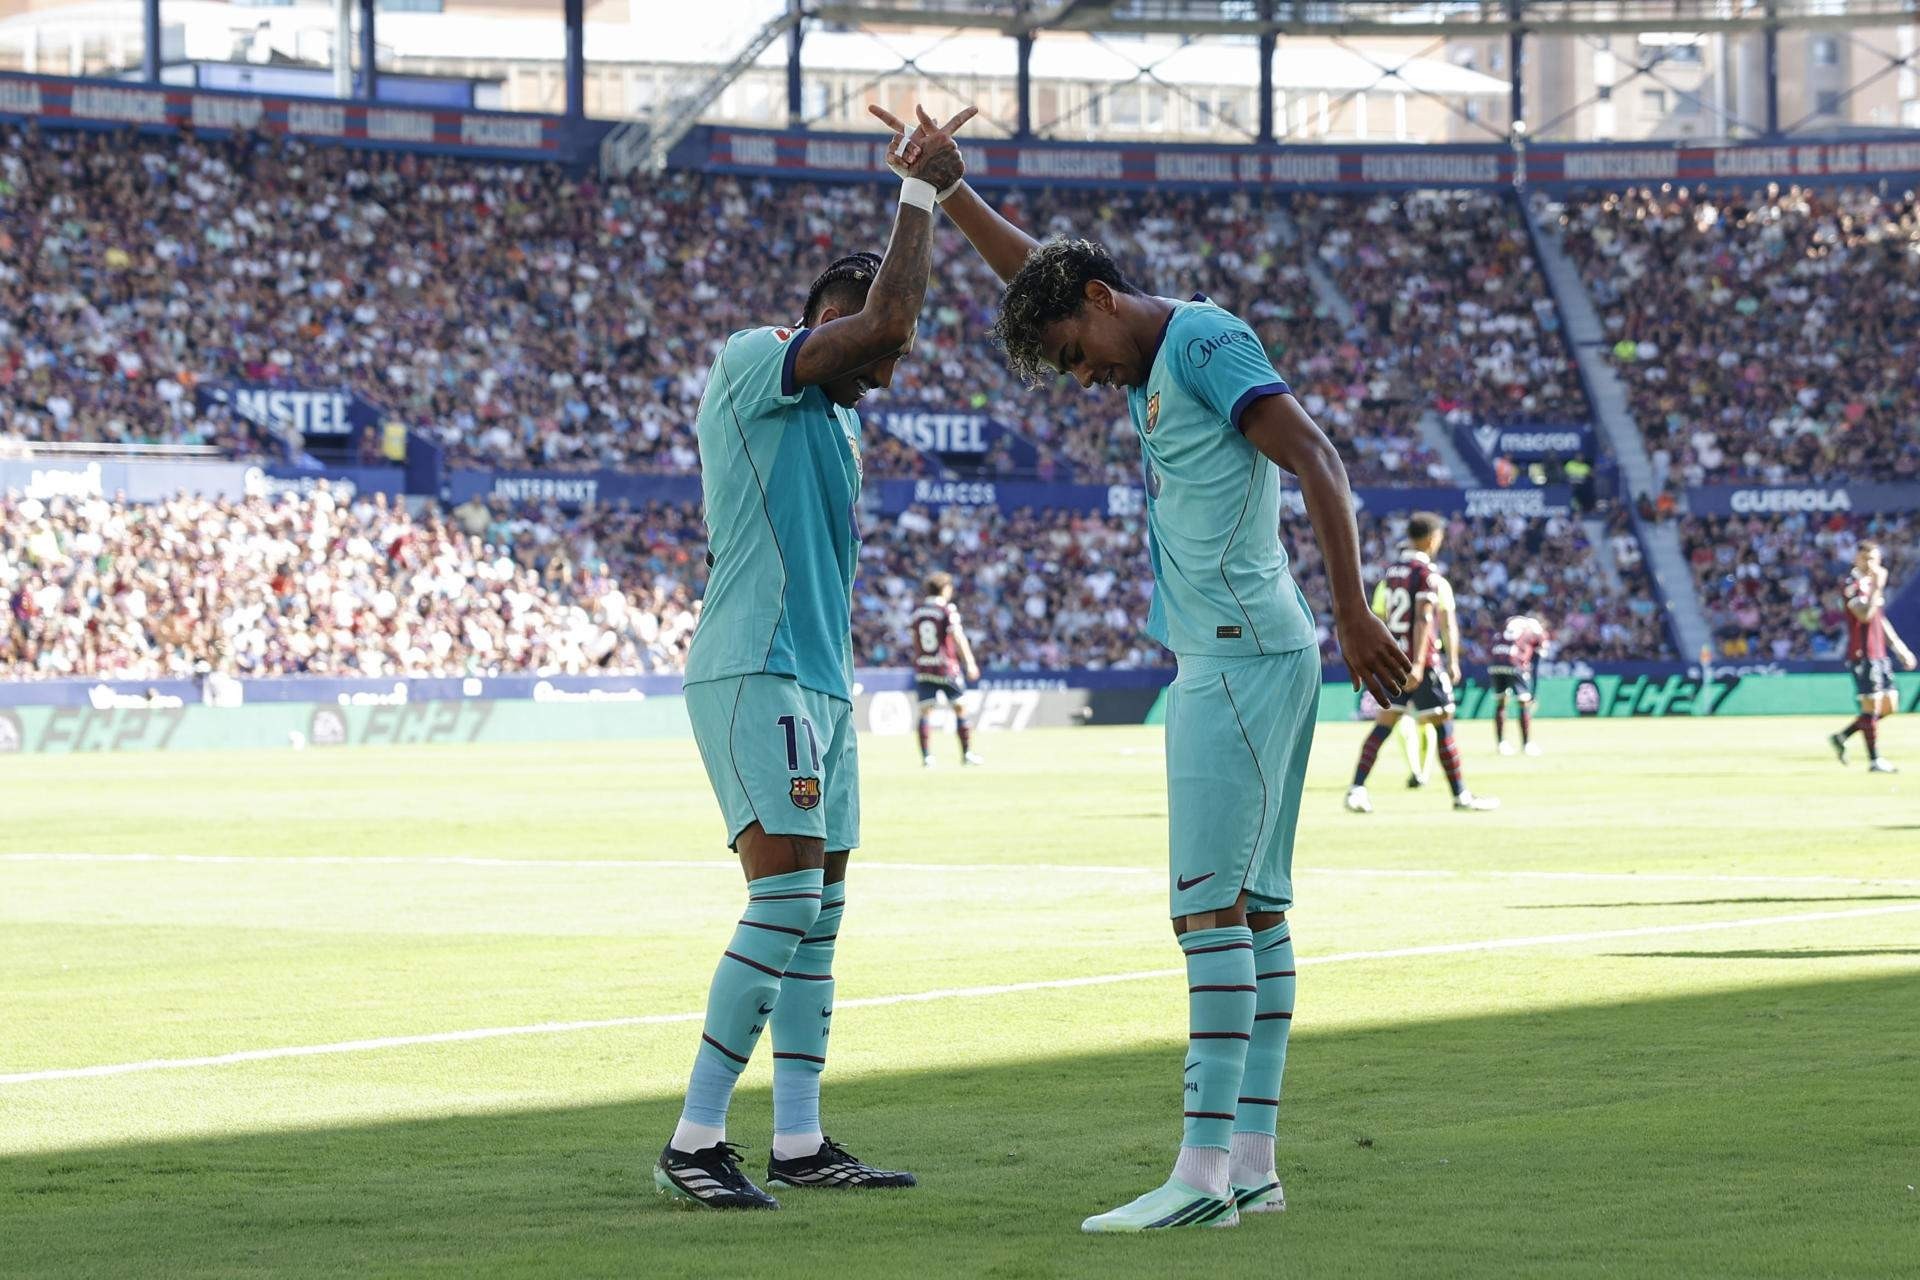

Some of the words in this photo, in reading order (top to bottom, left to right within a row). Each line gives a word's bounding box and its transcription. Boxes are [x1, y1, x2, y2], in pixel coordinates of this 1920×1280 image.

[1187, 331, 1249, 368] Midea
[214, 389, 353, 434] MSTEL
[869, 411, 988, 452] MSTEL
[1501, 432, 1580, 451] macron
[1730, 490, 1851, 511] GUEROLA
[919, 620, 939, 652] 8
[777, 715, 820, 772] 11
